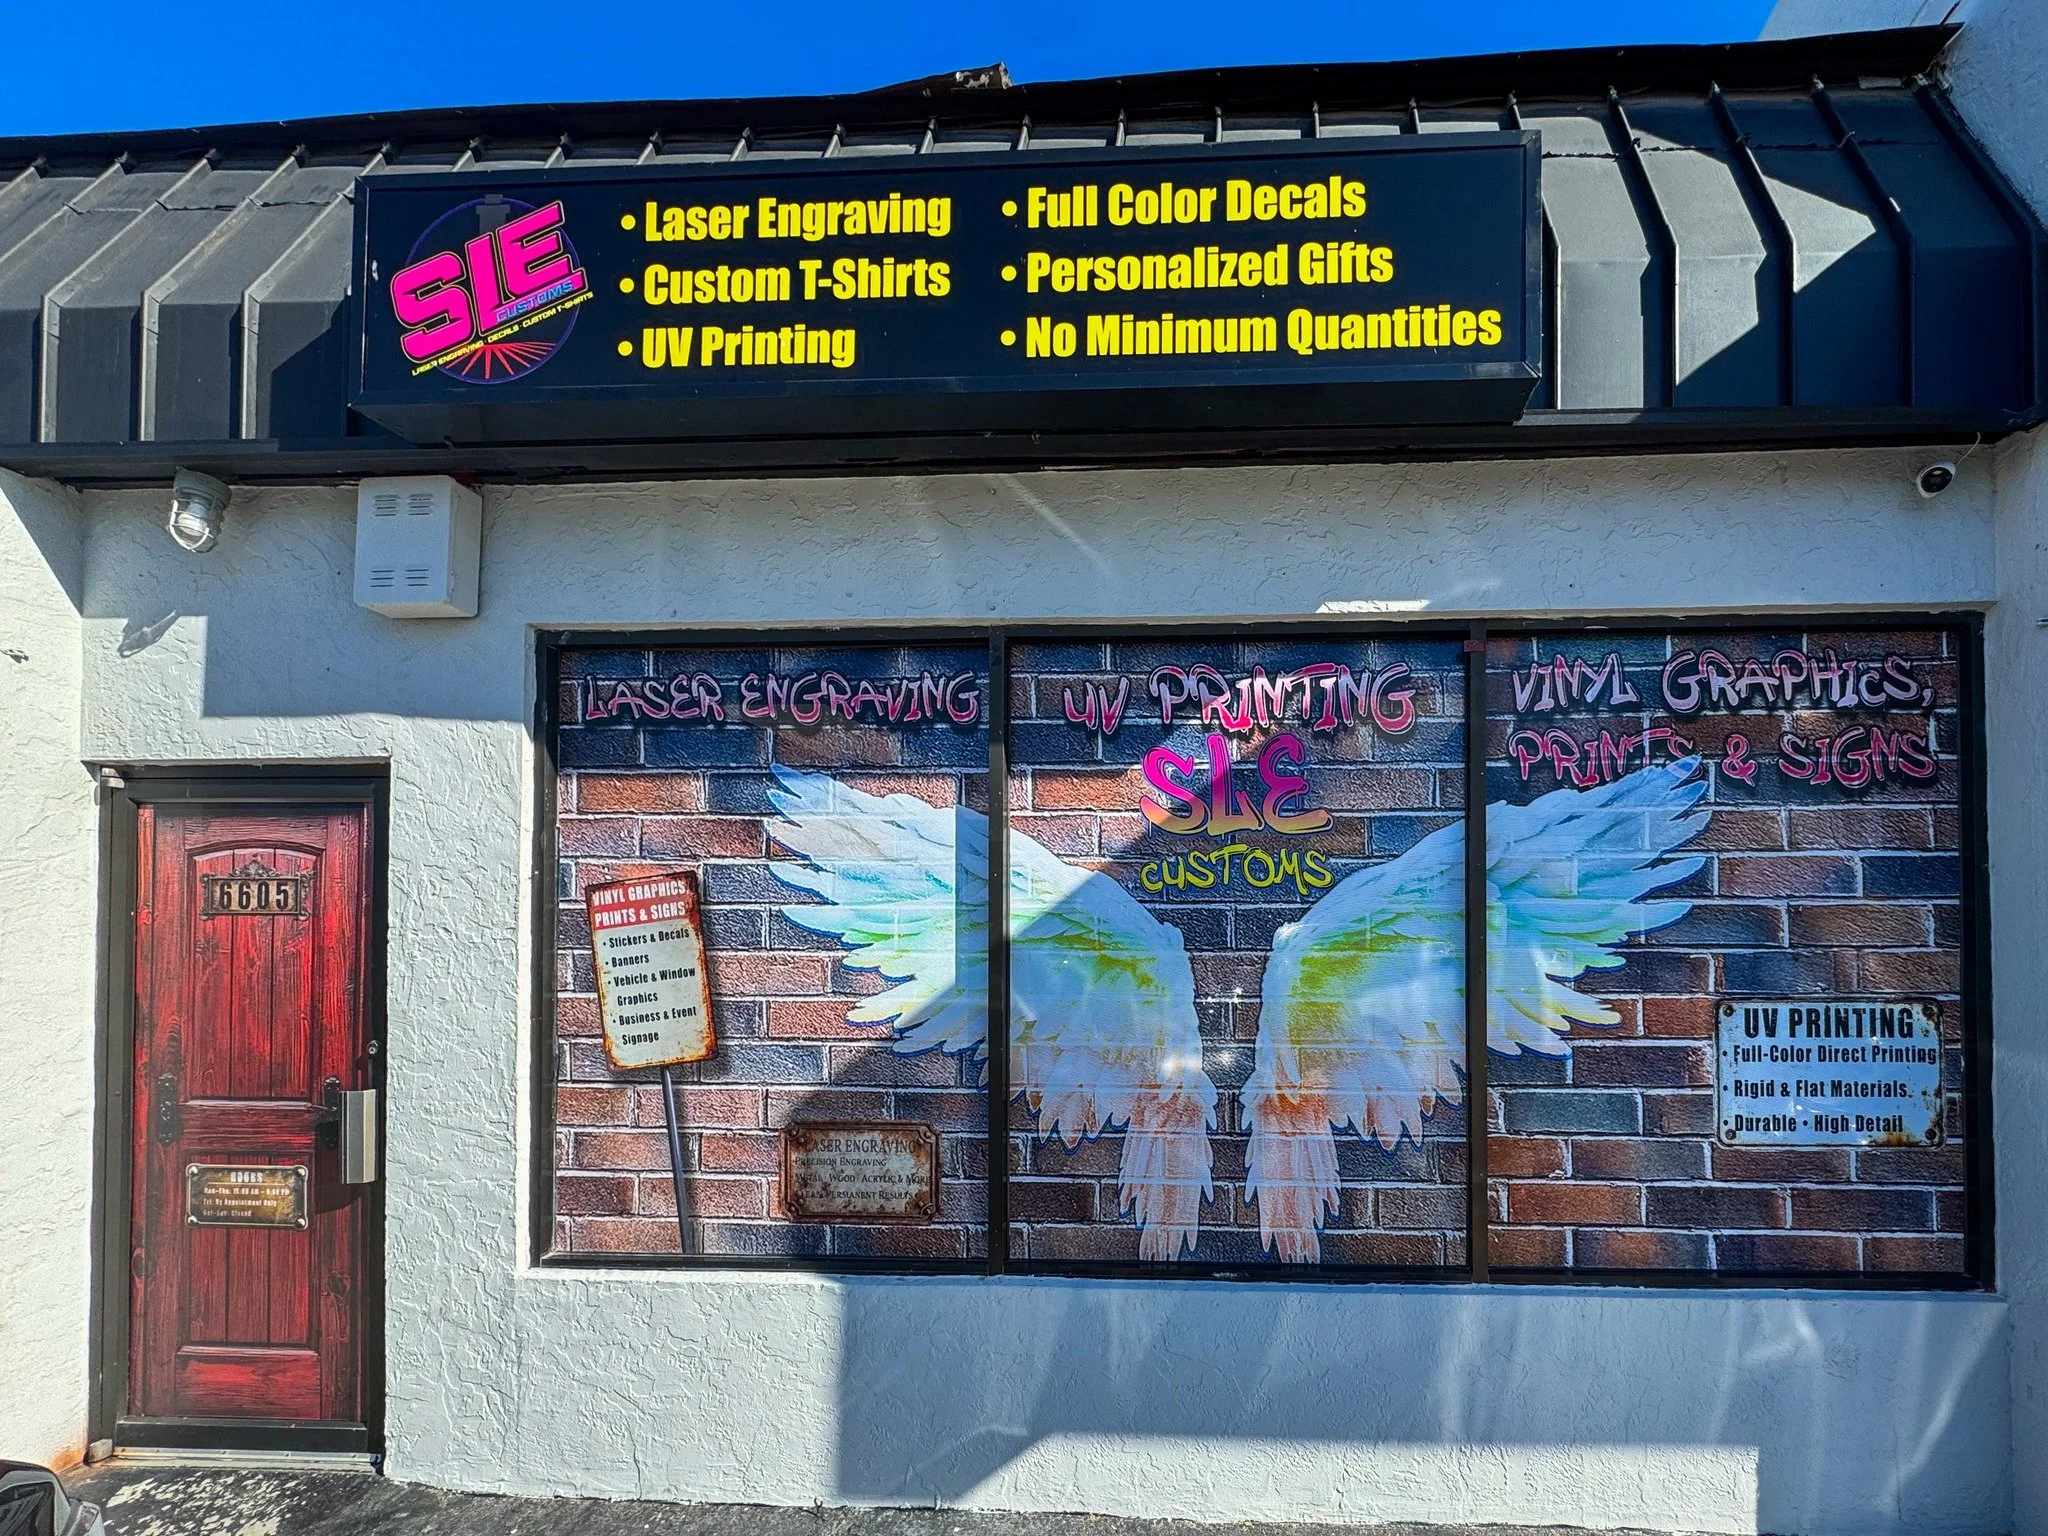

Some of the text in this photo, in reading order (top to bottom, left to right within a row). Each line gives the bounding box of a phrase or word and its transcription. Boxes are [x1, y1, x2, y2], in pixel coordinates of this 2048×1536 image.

[644, 192, 952, 242] Laser Engraving
[1027, 176, 1366, 228] Full Color Decals
[643, 257, 951, 304] Custom T-Shirts
[1027, 241, 1393, 293] Personalized Gifts
[496, 280, 574, 323] CUSTOMS
[487, 325, 519, 343] DECALS
[522, 307, 556, 328] CUSTOM
[1026, 304, 1502, 357] No Minimum Quantities
[641, 323, 855, 369] UV Printing
[585, 671, 980, 724] LASER ENGRAVING
[1063, 662, 1416, 735] UV PRINTING
[1513, 652, 1639, 712] VINYL
[1722, 733, 1757, 787] &
[1779, 726, 1938, 788] SIGNS
[1139, 732, 1334, 837] SLE
[1140, 843, 1334, 895] CUSTOMS
[220, 881, 289, 910] 6605
[593, 889, 626, 906] VINYL
[594, 901, 686, 928] PRINTS & SIGNS
[609, 928, 690, 949] Stickers & Decals
[611, 953, 649, 968] Banners
[614, 967, 696, 987] Vehicle & Window
[617, 992, 659, 1007] Graphics
[619, 1006, 697, 1026] Business & Event
[622, 1030, 659, 1046] Signage
[1744, 1005, 1914, 1039] UV PRINTING
[1733, 1045, 1937, 1066] Full-Color Direct Printing
[1734, 1080, 1774, 1100] Rigid
[1780, 1082, 1790, 1097] &
[1796, 1080, 1825, 1097] Flat
[1734, 1115, 1903, 1135] Durable High Detail
[230, 1171, 264, 1183] HOURS
[840, 1157, 887, 1167] ENGRAVING
